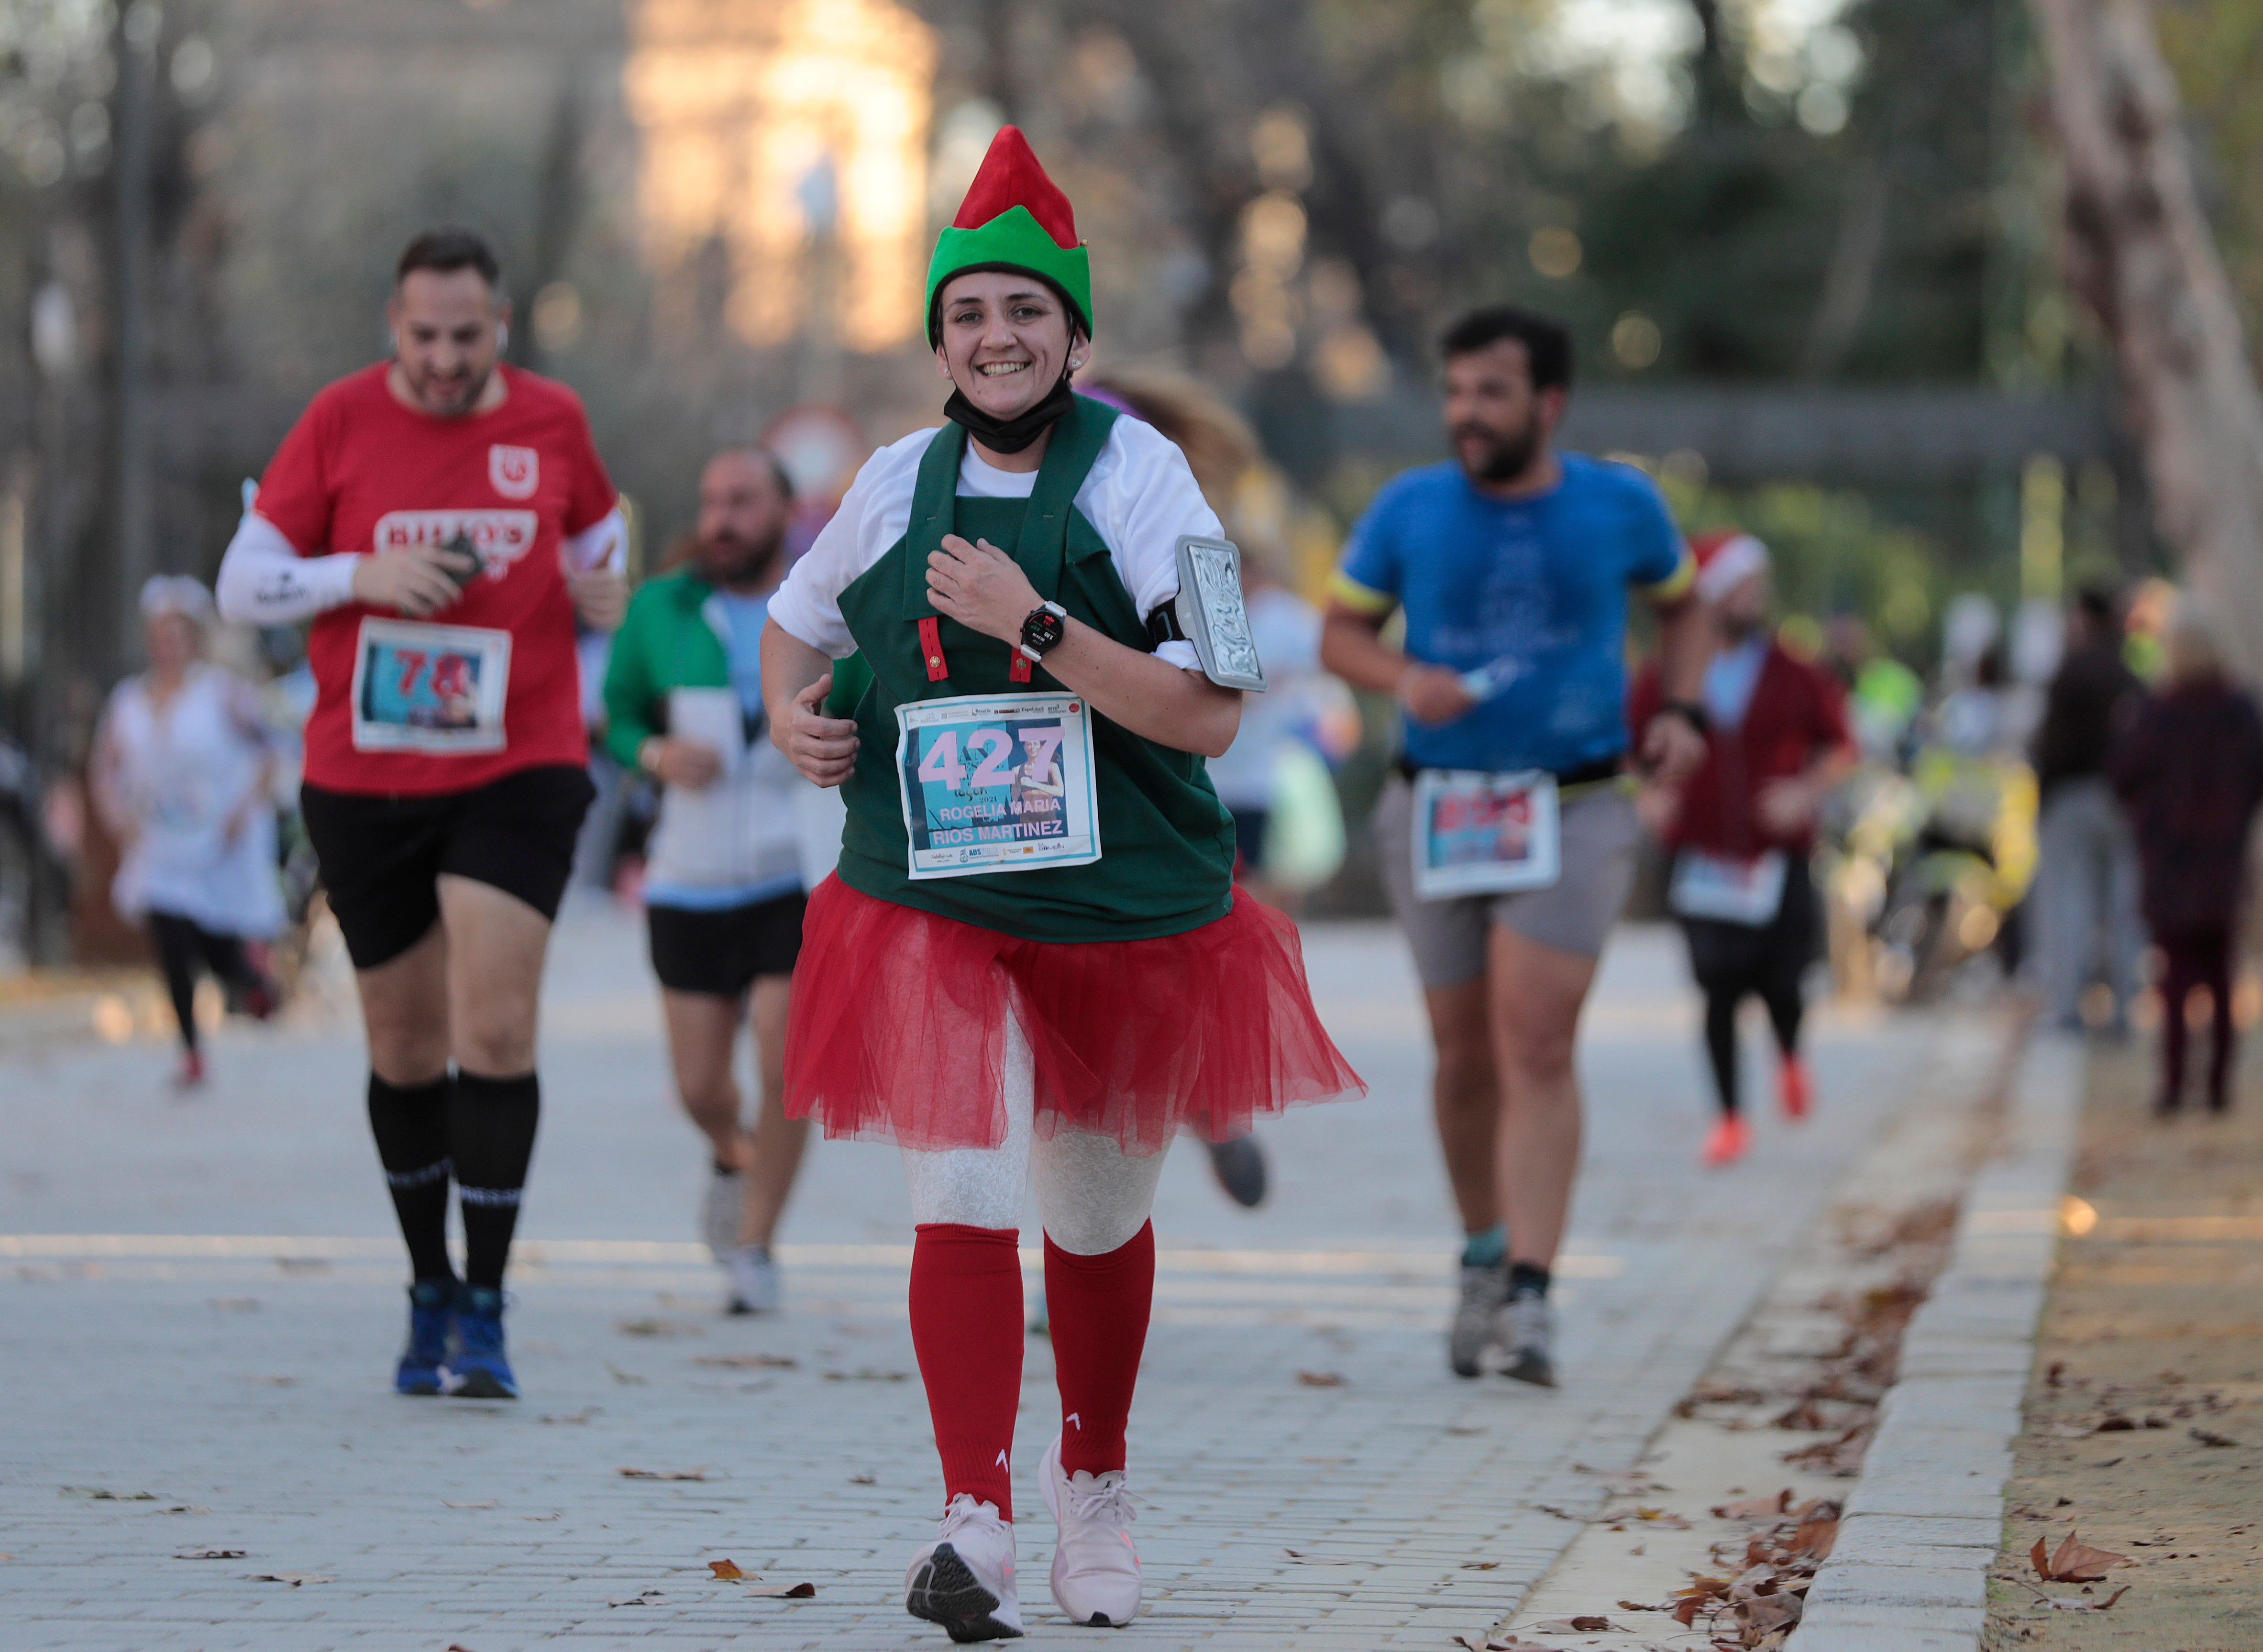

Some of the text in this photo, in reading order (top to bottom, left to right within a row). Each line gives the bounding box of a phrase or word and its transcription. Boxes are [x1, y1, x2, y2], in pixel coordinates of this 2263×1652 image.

[918, 726, 1065, 790] 427
[940, 798, 1061, 821] ROGELIA MARIA
[933, 819, 1063, 845] RIOS MARTINEZ
